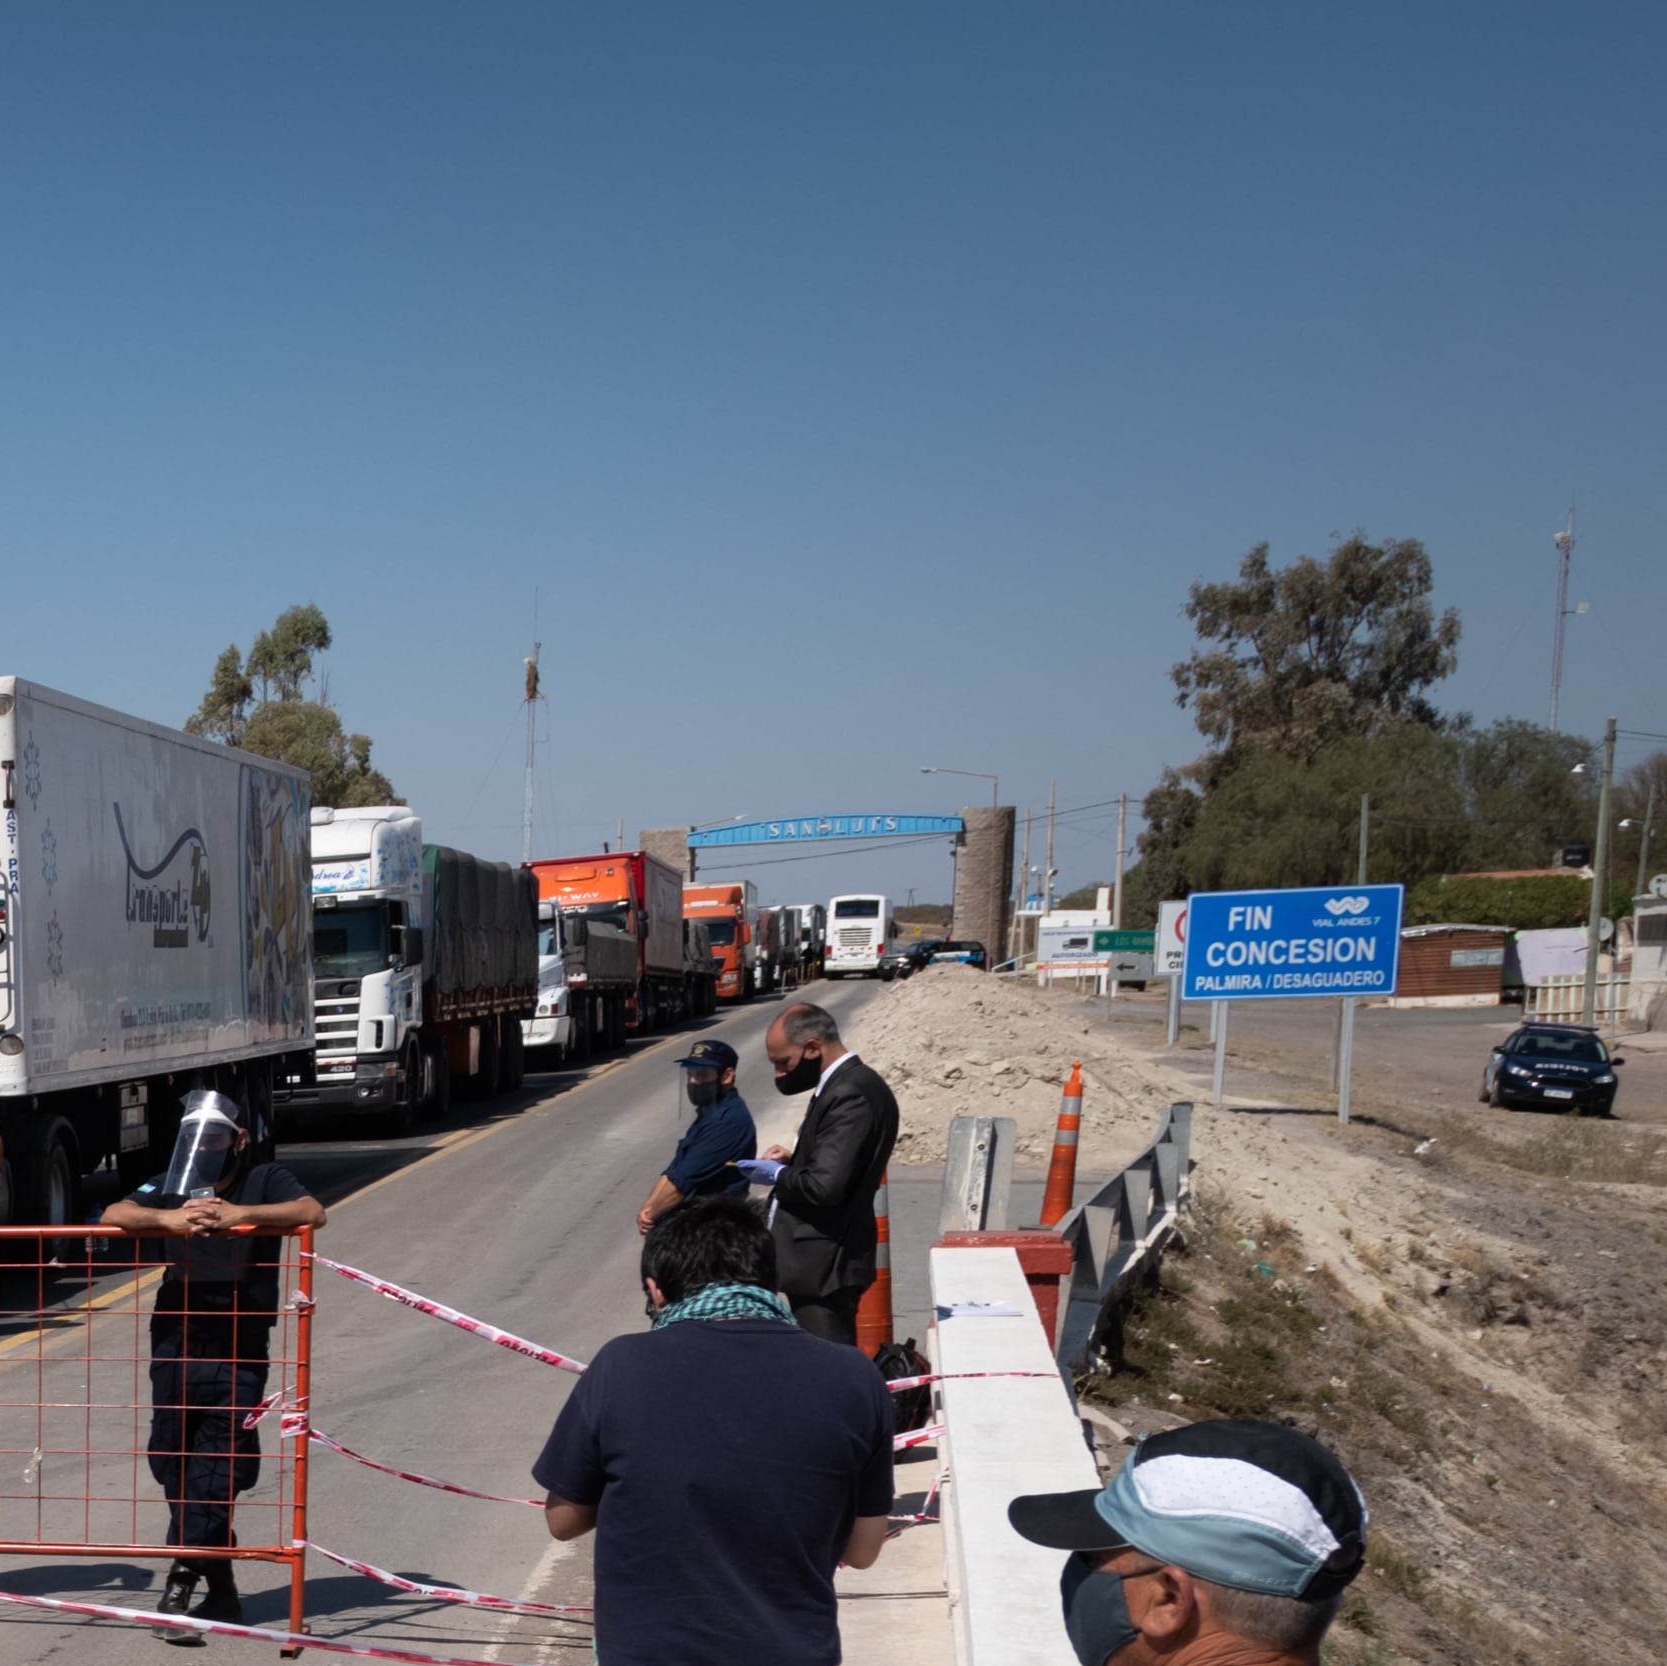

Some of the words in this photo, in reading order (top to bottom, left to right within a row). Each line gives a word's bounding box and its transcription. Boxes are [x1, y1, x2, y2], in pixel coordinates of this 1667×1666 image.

[770, 819, 812, 838] SAN
[836, 816, 897, 835] LUIS
[1228, 905, 1273, 932] FIN
[1312, 918, 1335, 928] VIAL
[1336, 916, 1371, 927] ANDES
[1373, 916, 1381, 926] 7
[1206, 936, 1377, 967] CONCESION
[1195, 973, 1262, 991] PALMIRA
[1273, 969, 1385, 989] DESAGUADERO
[330, 1064, 353, 1073] 420
